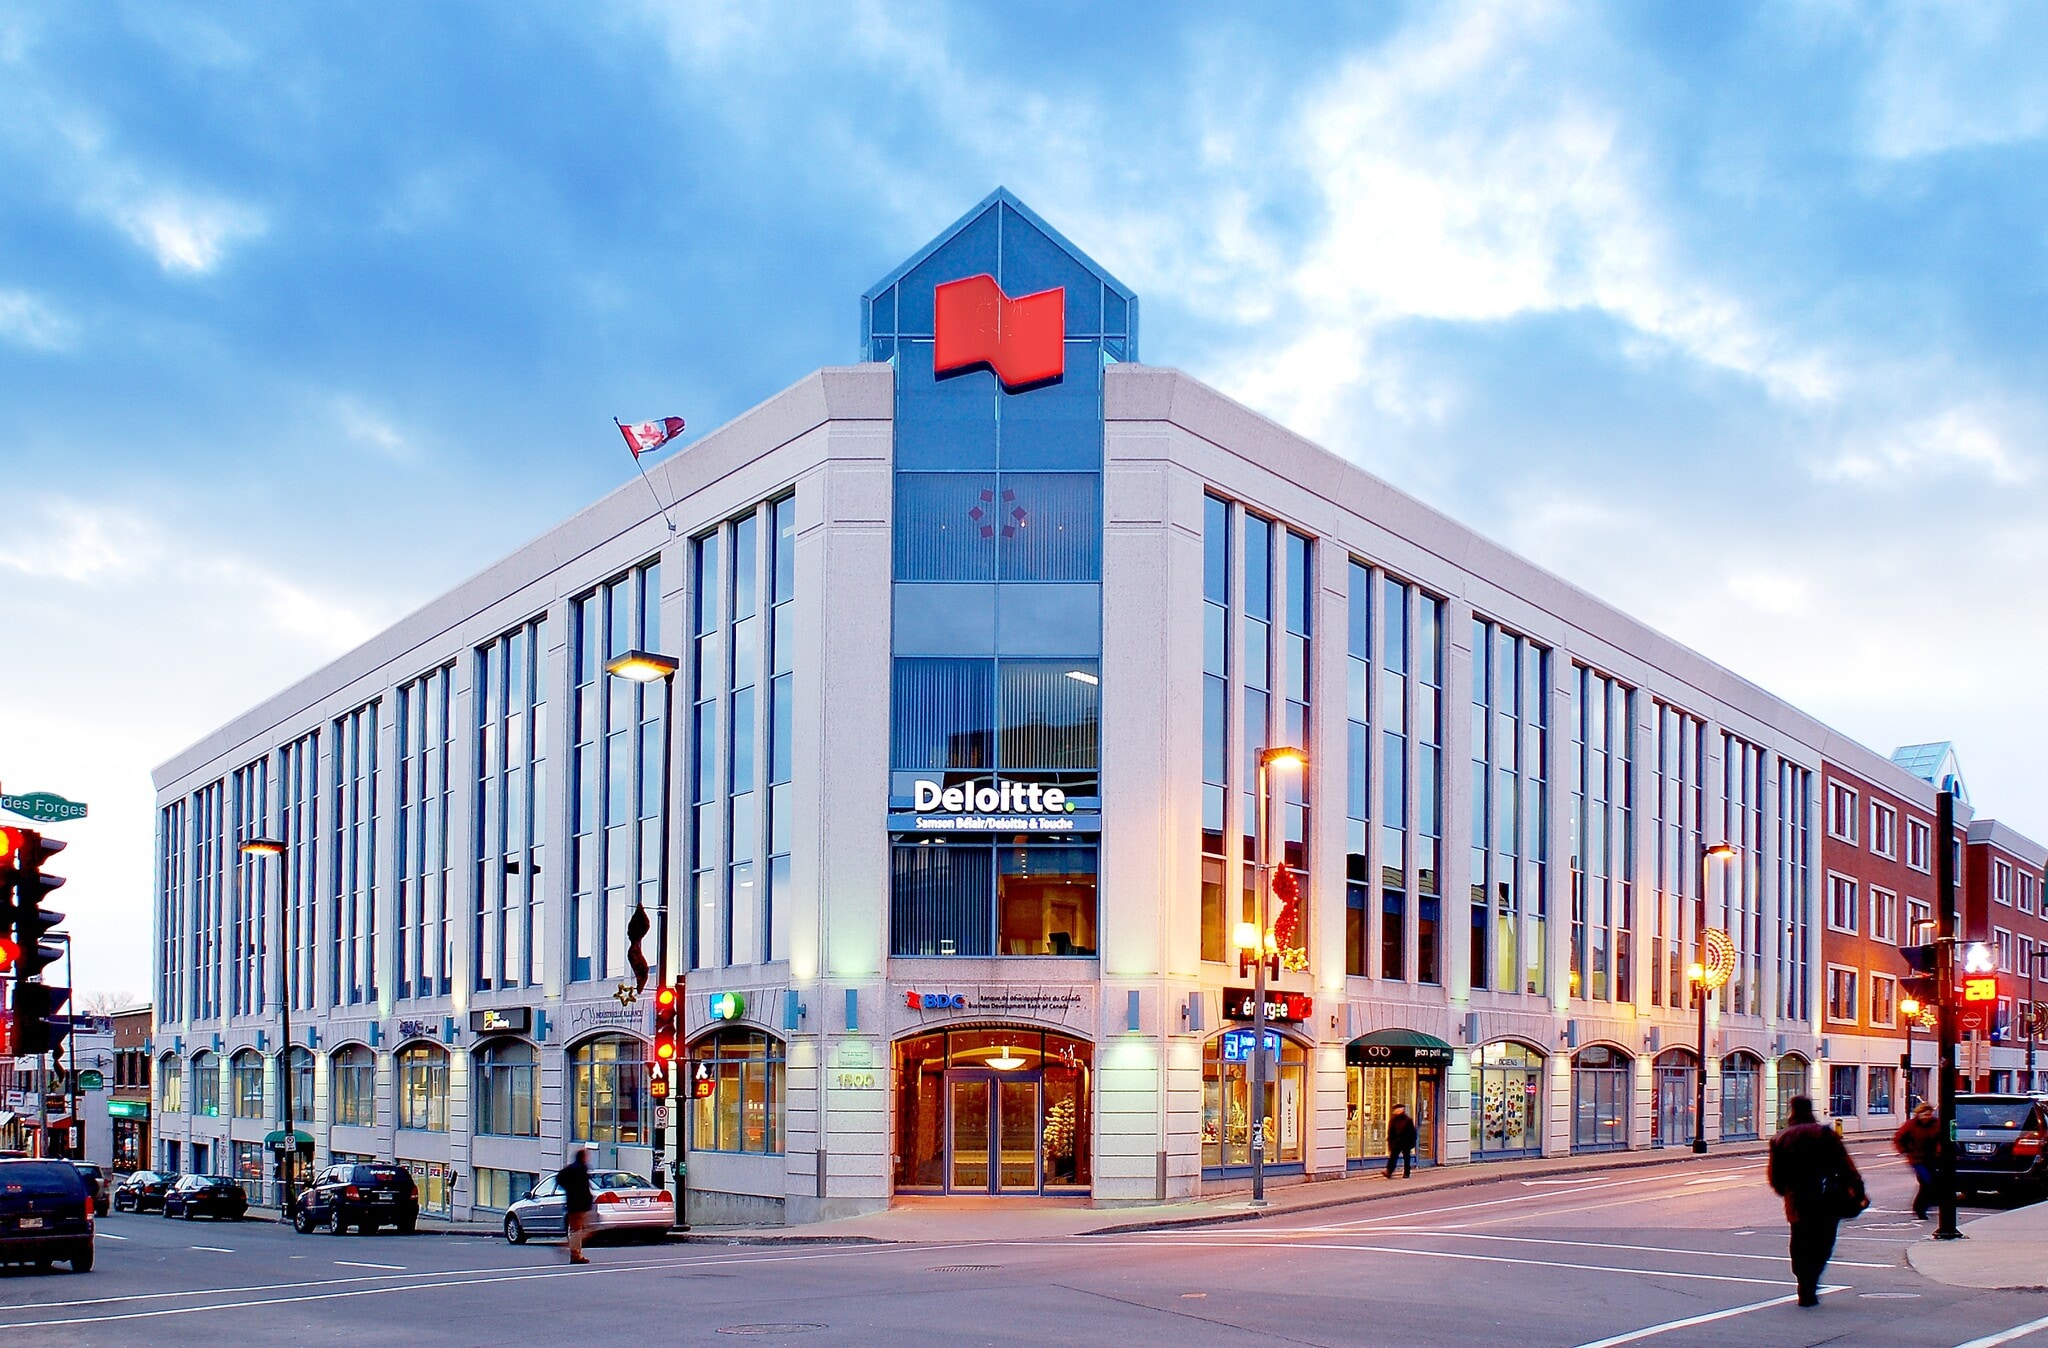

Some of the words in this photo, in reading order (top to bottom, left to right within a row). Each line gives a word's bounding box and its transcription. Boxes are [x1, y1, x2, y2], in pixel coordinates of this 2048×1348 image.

[914, 780, 1076, 813] Deloitte.
[3, 797, 31, 811] des
[35, 799, 87, 817] Forges
[915, 816, 955, 830] Samson
[1028, 817, 1039, 830] &
[1039, 816, 1074, 830] Touche
[1965, 979, 1996, 1000] 28
[923, 993, 966, 1010] BDC
[1415, 1047, 1429, 1057] jean
[651, 1082, 666, 1095] 28
